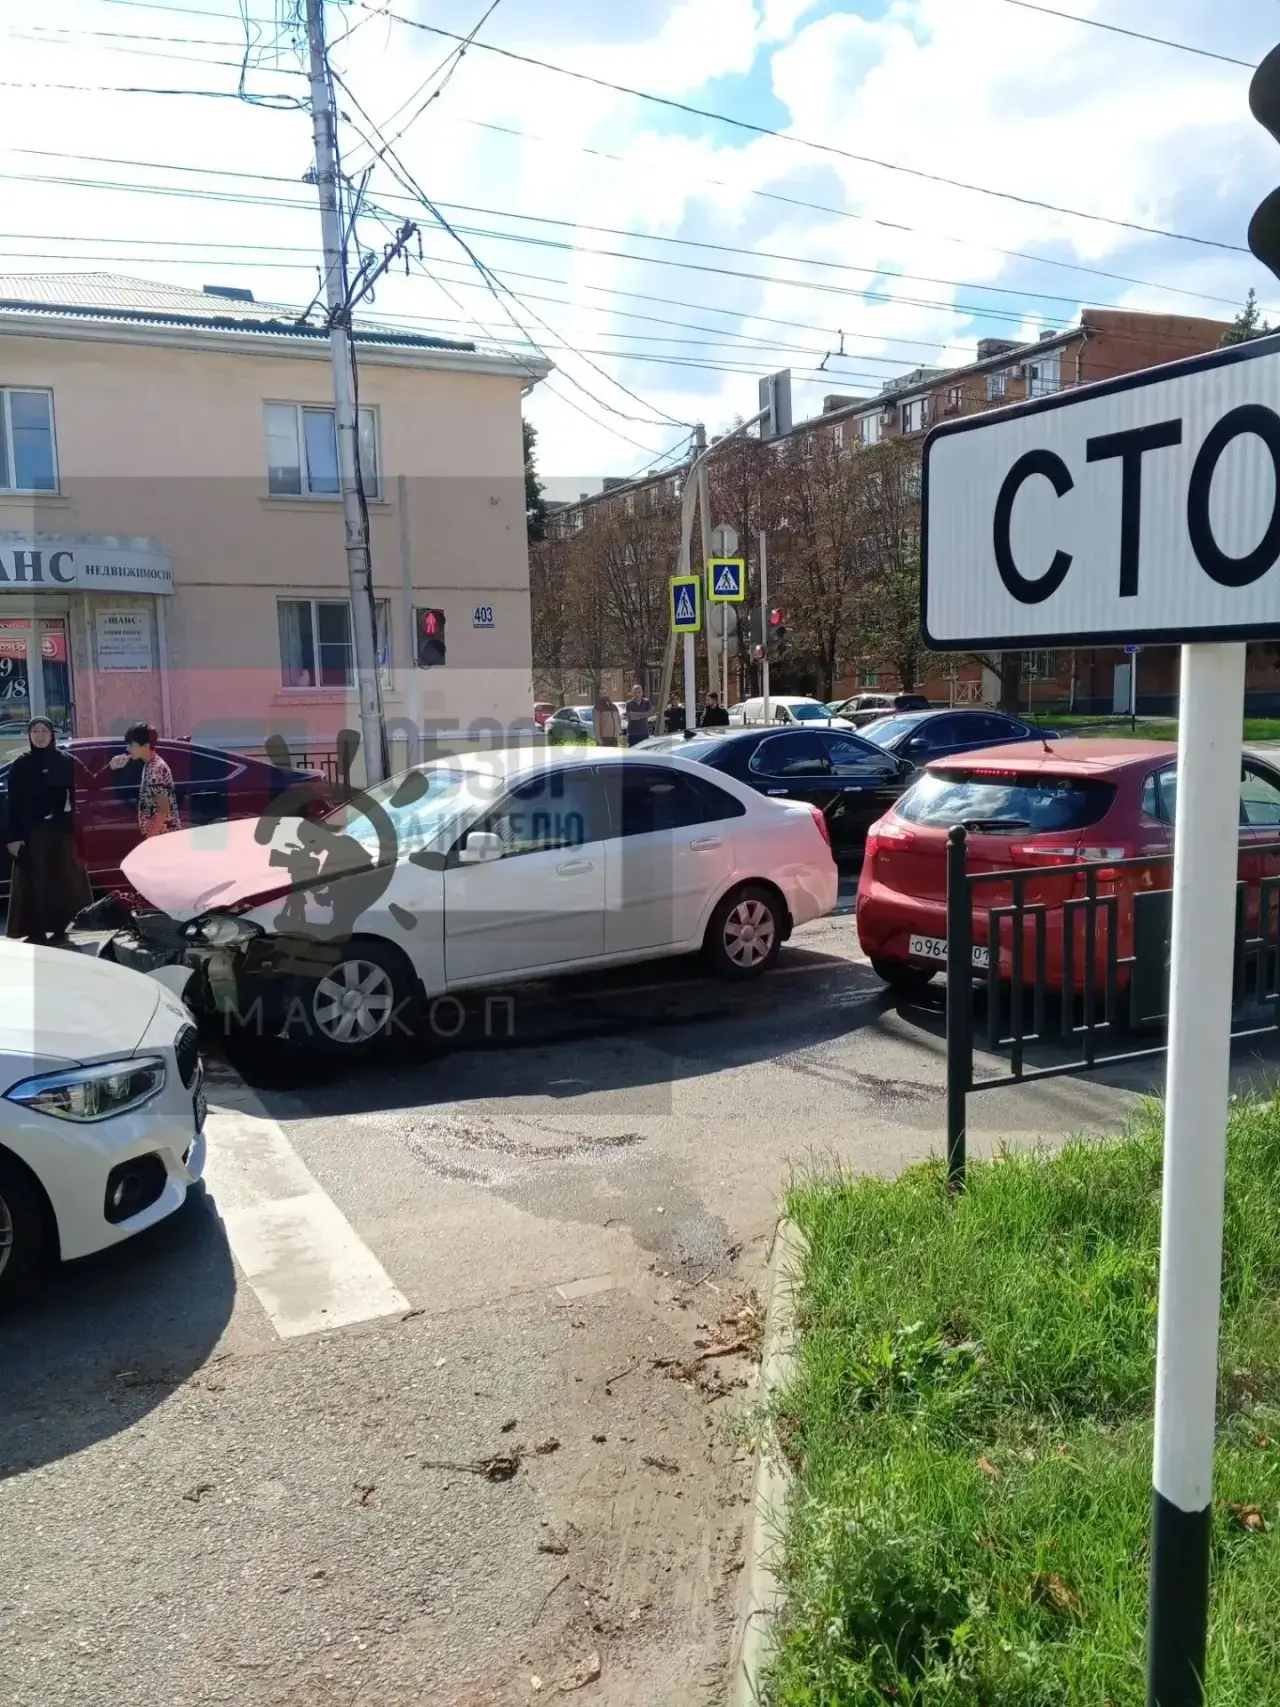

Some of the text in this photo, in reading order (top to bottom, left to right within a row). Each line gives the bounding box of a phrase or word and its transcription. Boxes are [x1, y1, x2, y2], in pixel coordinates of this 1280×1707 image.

[993, 403, 1280, 605] СТО
[85, 564, 172, 581] НЕДВИЖИМОСТИ
[474, 606, 493, 622] 403
